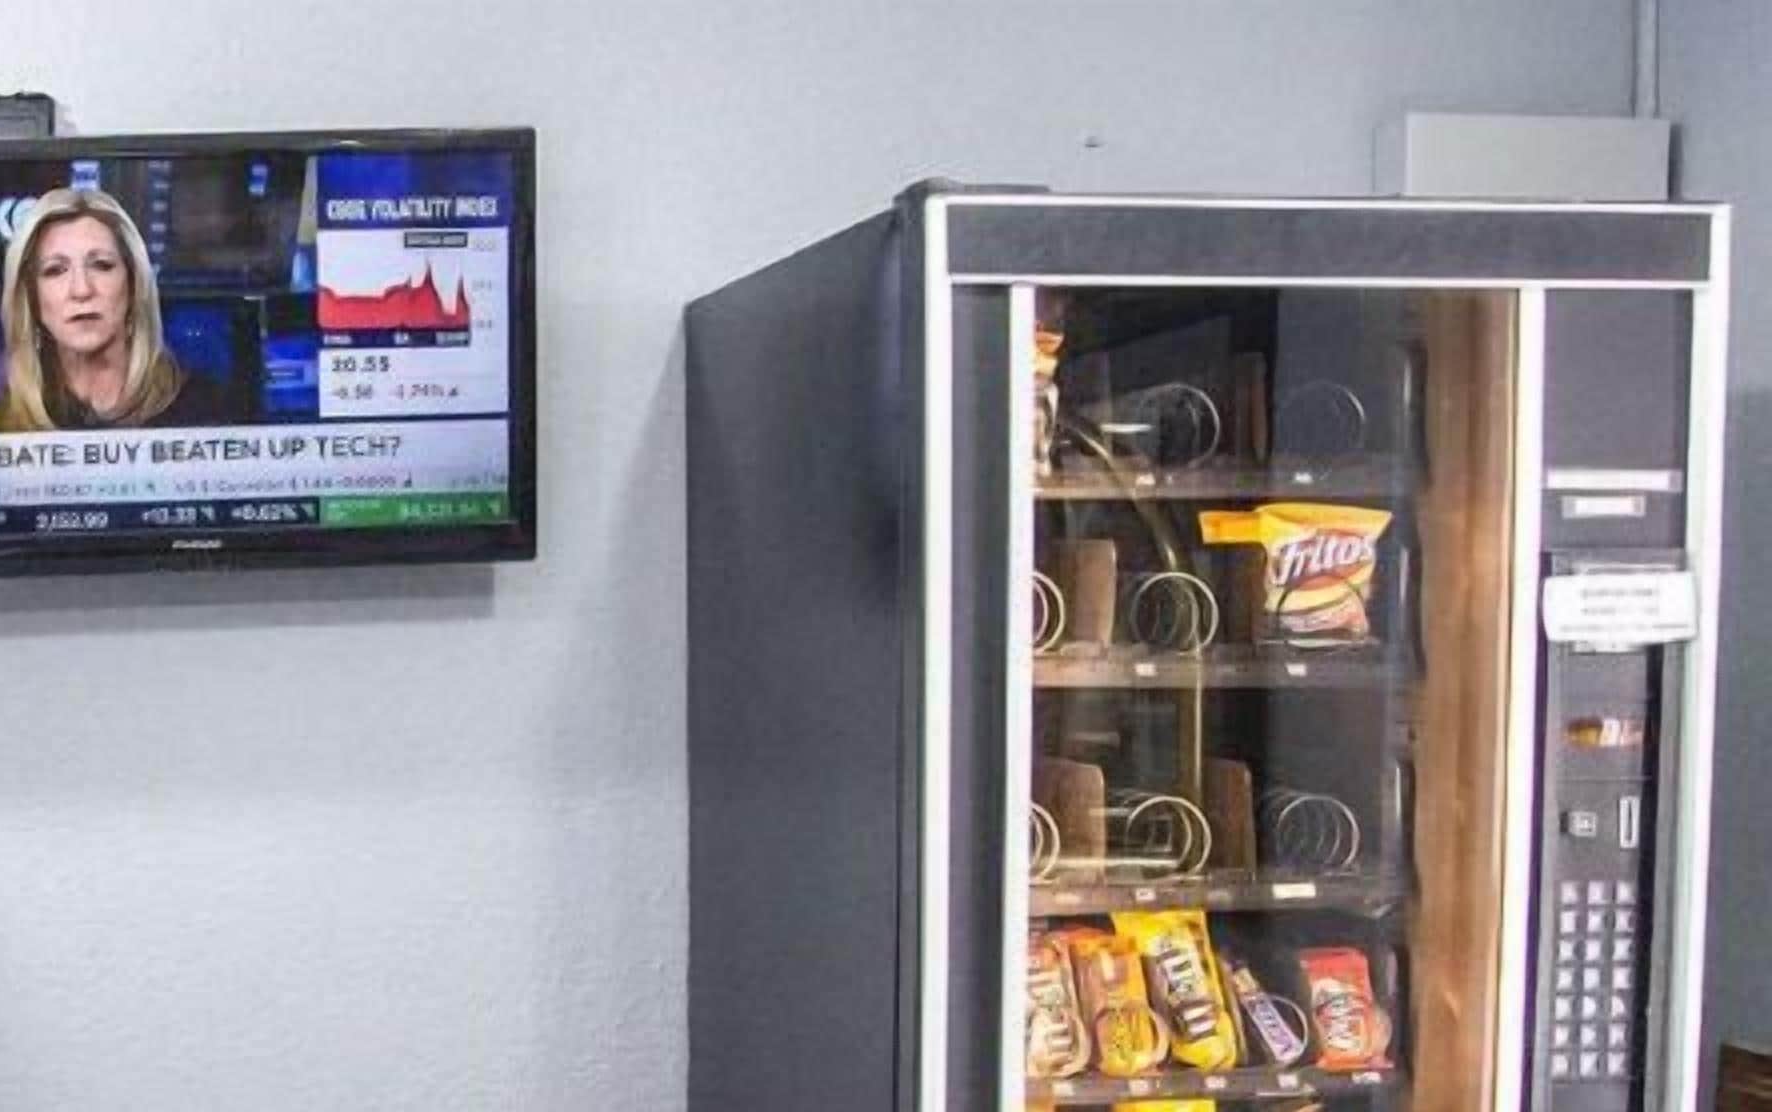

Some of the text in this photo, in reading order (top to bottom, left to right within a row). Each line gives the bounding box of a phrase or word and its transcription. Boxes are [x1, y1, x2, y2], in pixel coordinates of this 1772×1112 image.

[84, 440, 141, 465] BUY
[150, 438, 260, 463] BEATEN
[267, 437, 306, 460] UP
[318, 435, 402, 459] TECH?
[1269, 535, 1377, 586] Fritos
